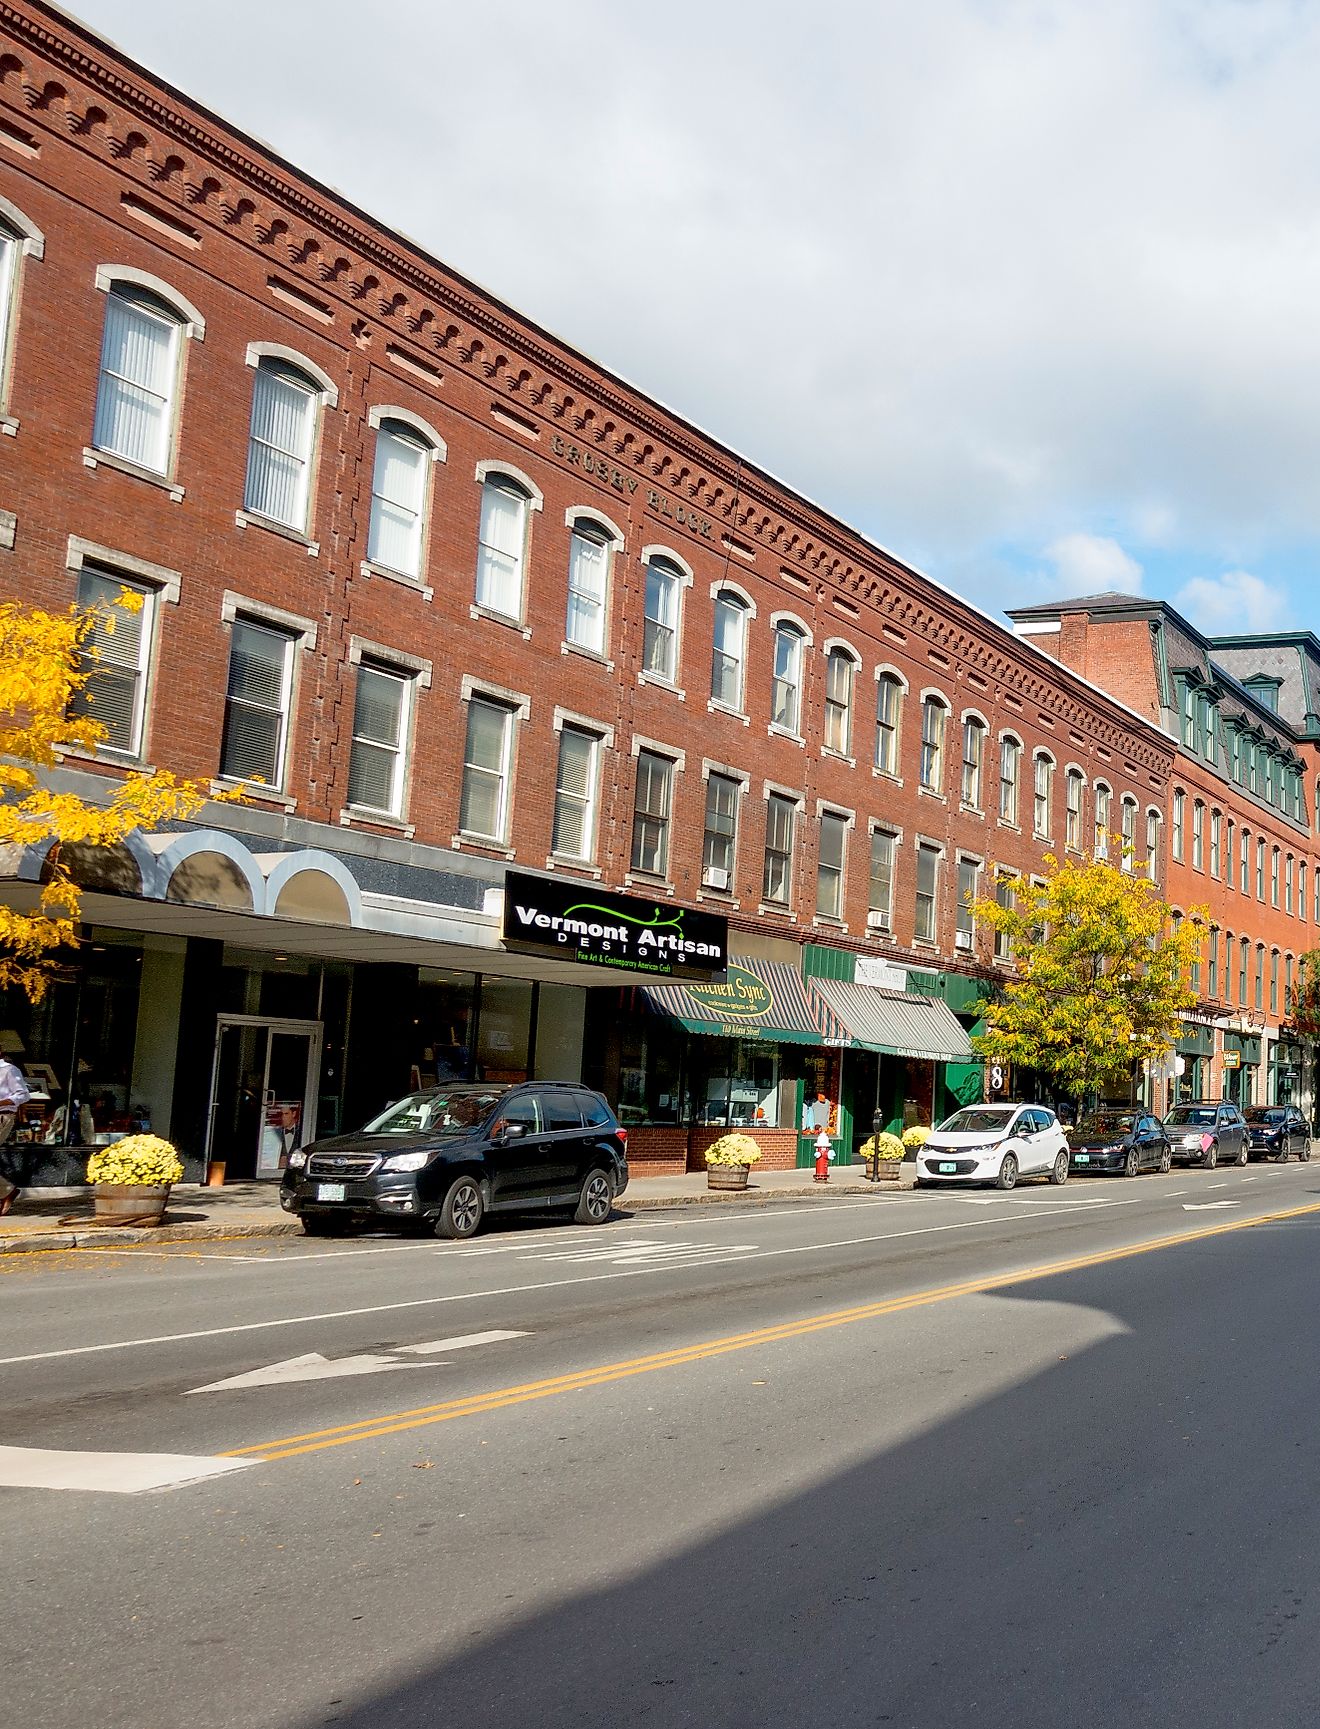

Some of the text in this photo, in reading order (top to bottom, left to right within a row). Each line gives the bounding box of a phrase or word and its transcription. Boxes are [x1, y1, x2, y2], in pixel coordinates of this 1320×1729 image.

[515, 905, 721, 958] Vermont Artisan
[577, 950, 588, 960] Fine
[589, 953, 598, 962] Art
[735, 977, 767, 1004] Sync
[731, 1025, 746, 1036] Main
[746, 1026, 761, 1037] Street
[823, 1036, 852, 1048] GIFTS
